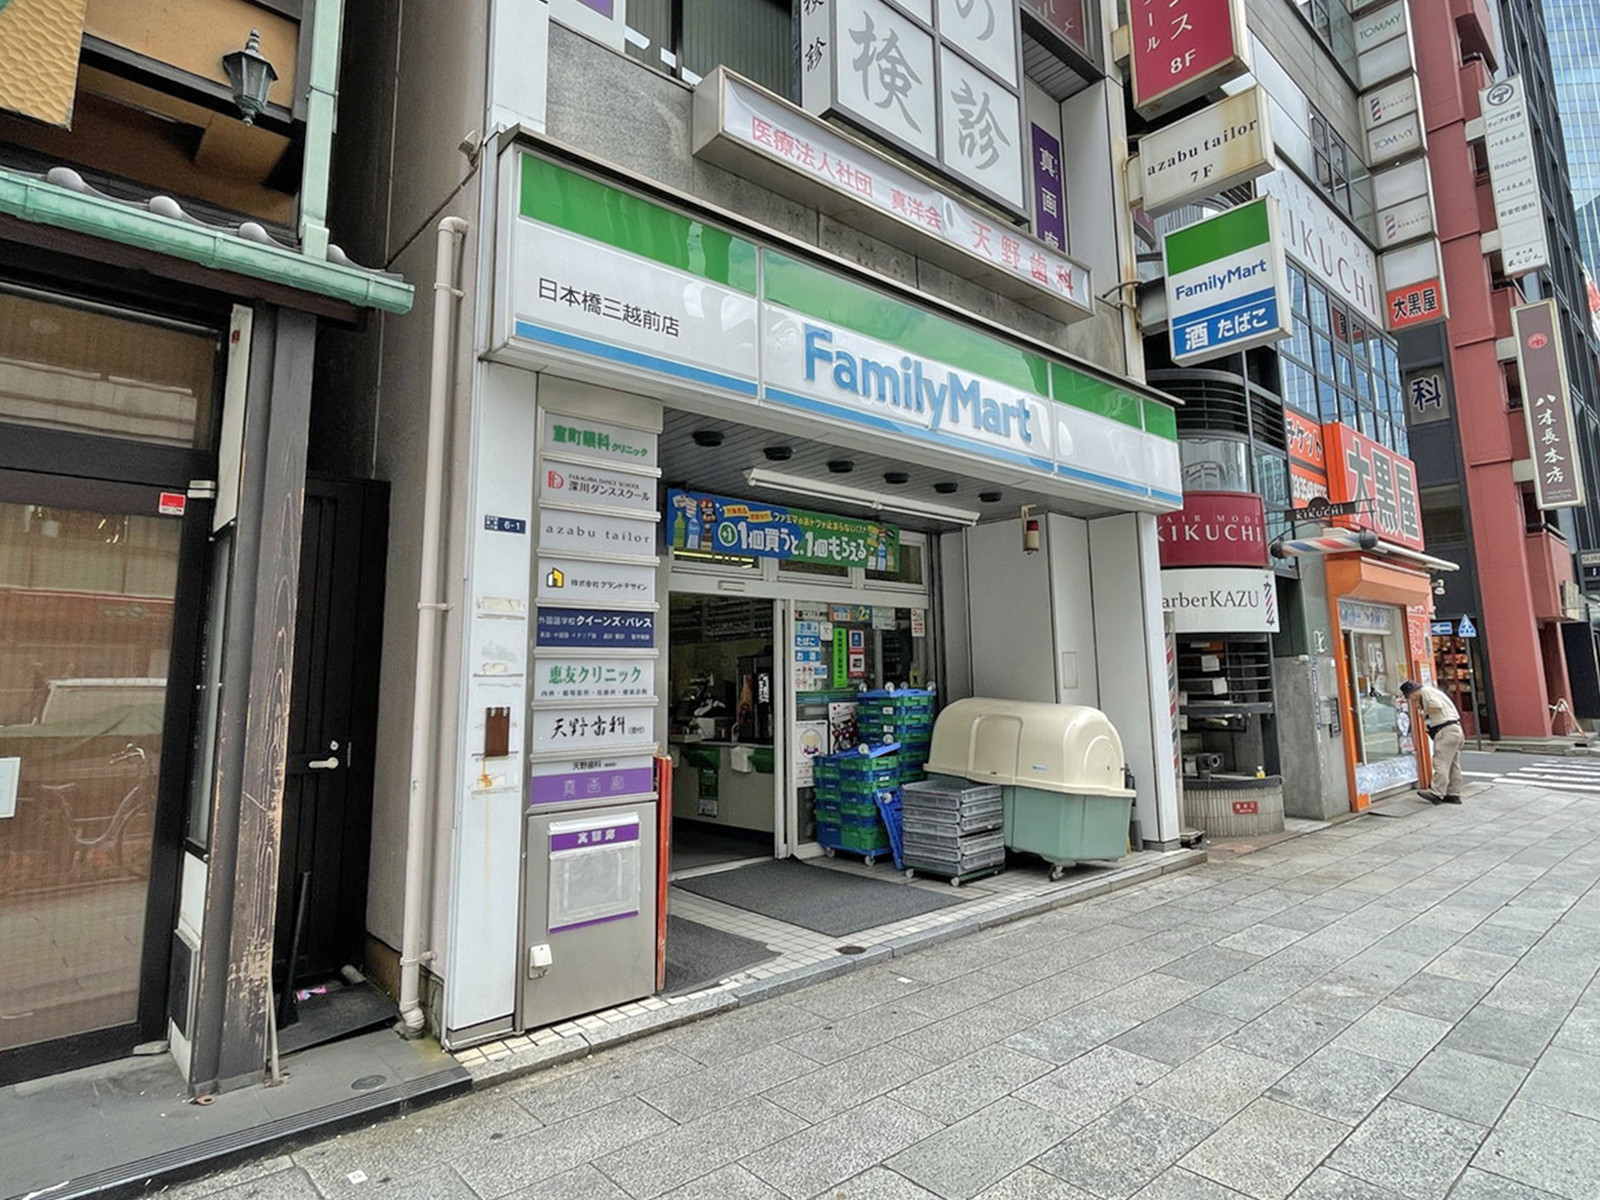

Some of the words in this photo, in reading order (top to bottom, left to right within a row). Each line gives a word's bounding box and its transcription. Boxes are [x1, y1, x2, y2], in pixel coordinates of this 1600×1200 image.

[1170, 48, 1196, 74] 8F
[1147, 145, 1198, 177] azabu
[1203, 119, 1257, 151] tailor
[1190, 164, 1214, 183] 7F
[751, 115, 874, 198] 医療法人社団
[891, 188, 943, 230] 真洋会
[971, 218, 1075, 296] 天野歯科
[1175, 258, 1267, 301] FamilyMart
[1288, 208, 1377, 316] IKUCHI
[538, 276, 681, 338] 日本橋三越前店
[1392, 288, 1437, 320] 大黒屋
[1184, 323, 1209, 351] 酒
[1217, 307, 1268, 339] たばこ
[803, 323, 1032, 444] FamilyMart
[1410, 374, 1442, 412] 科
[1534, 393, 1566, 485] 八木長本店
[568, 481, 651, 501] 深川ダンススクール
[1346, 436, 1421, 543] 大黒屋
[504, 520, 520, 531] 6-1
[546, 523, 596, 539] azabu
[605, 528, 650, 544] tailor
[1165, 514, 1200, 524] AIR
[1216, 514, 1260, 525] MODE
[1162, 590, 1259, 609] arberKAZU
[549, 665, 642, 685] 恵友クリニック
[550, 715, 625, 740] 天野歯科
